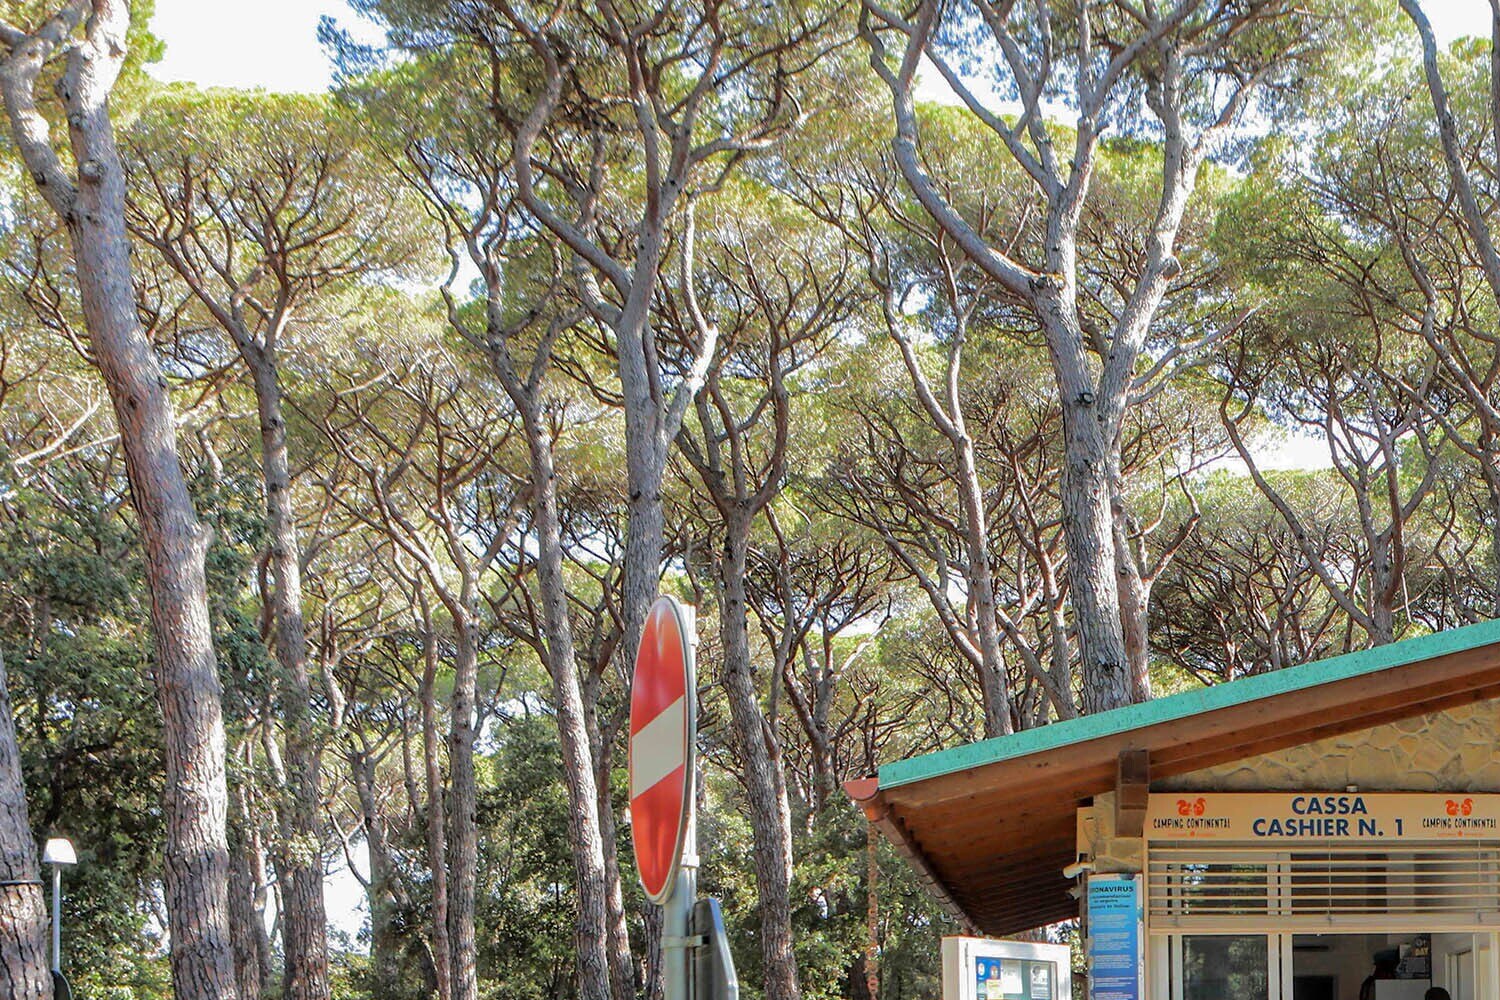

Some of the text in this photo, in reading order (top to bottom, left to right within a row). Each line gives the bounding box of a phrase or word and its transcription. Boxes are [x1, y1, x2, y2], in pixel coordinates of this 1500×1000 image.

[1291, 796, 1368, 815] CASSA
[1153, 817, 1231, 829] CAMPING CONTINENTAL
[1252, 818, 1404, 837] CASHIER N. 1
[1422, 817, 1497, 829] CAMPING CONTINENTAL
